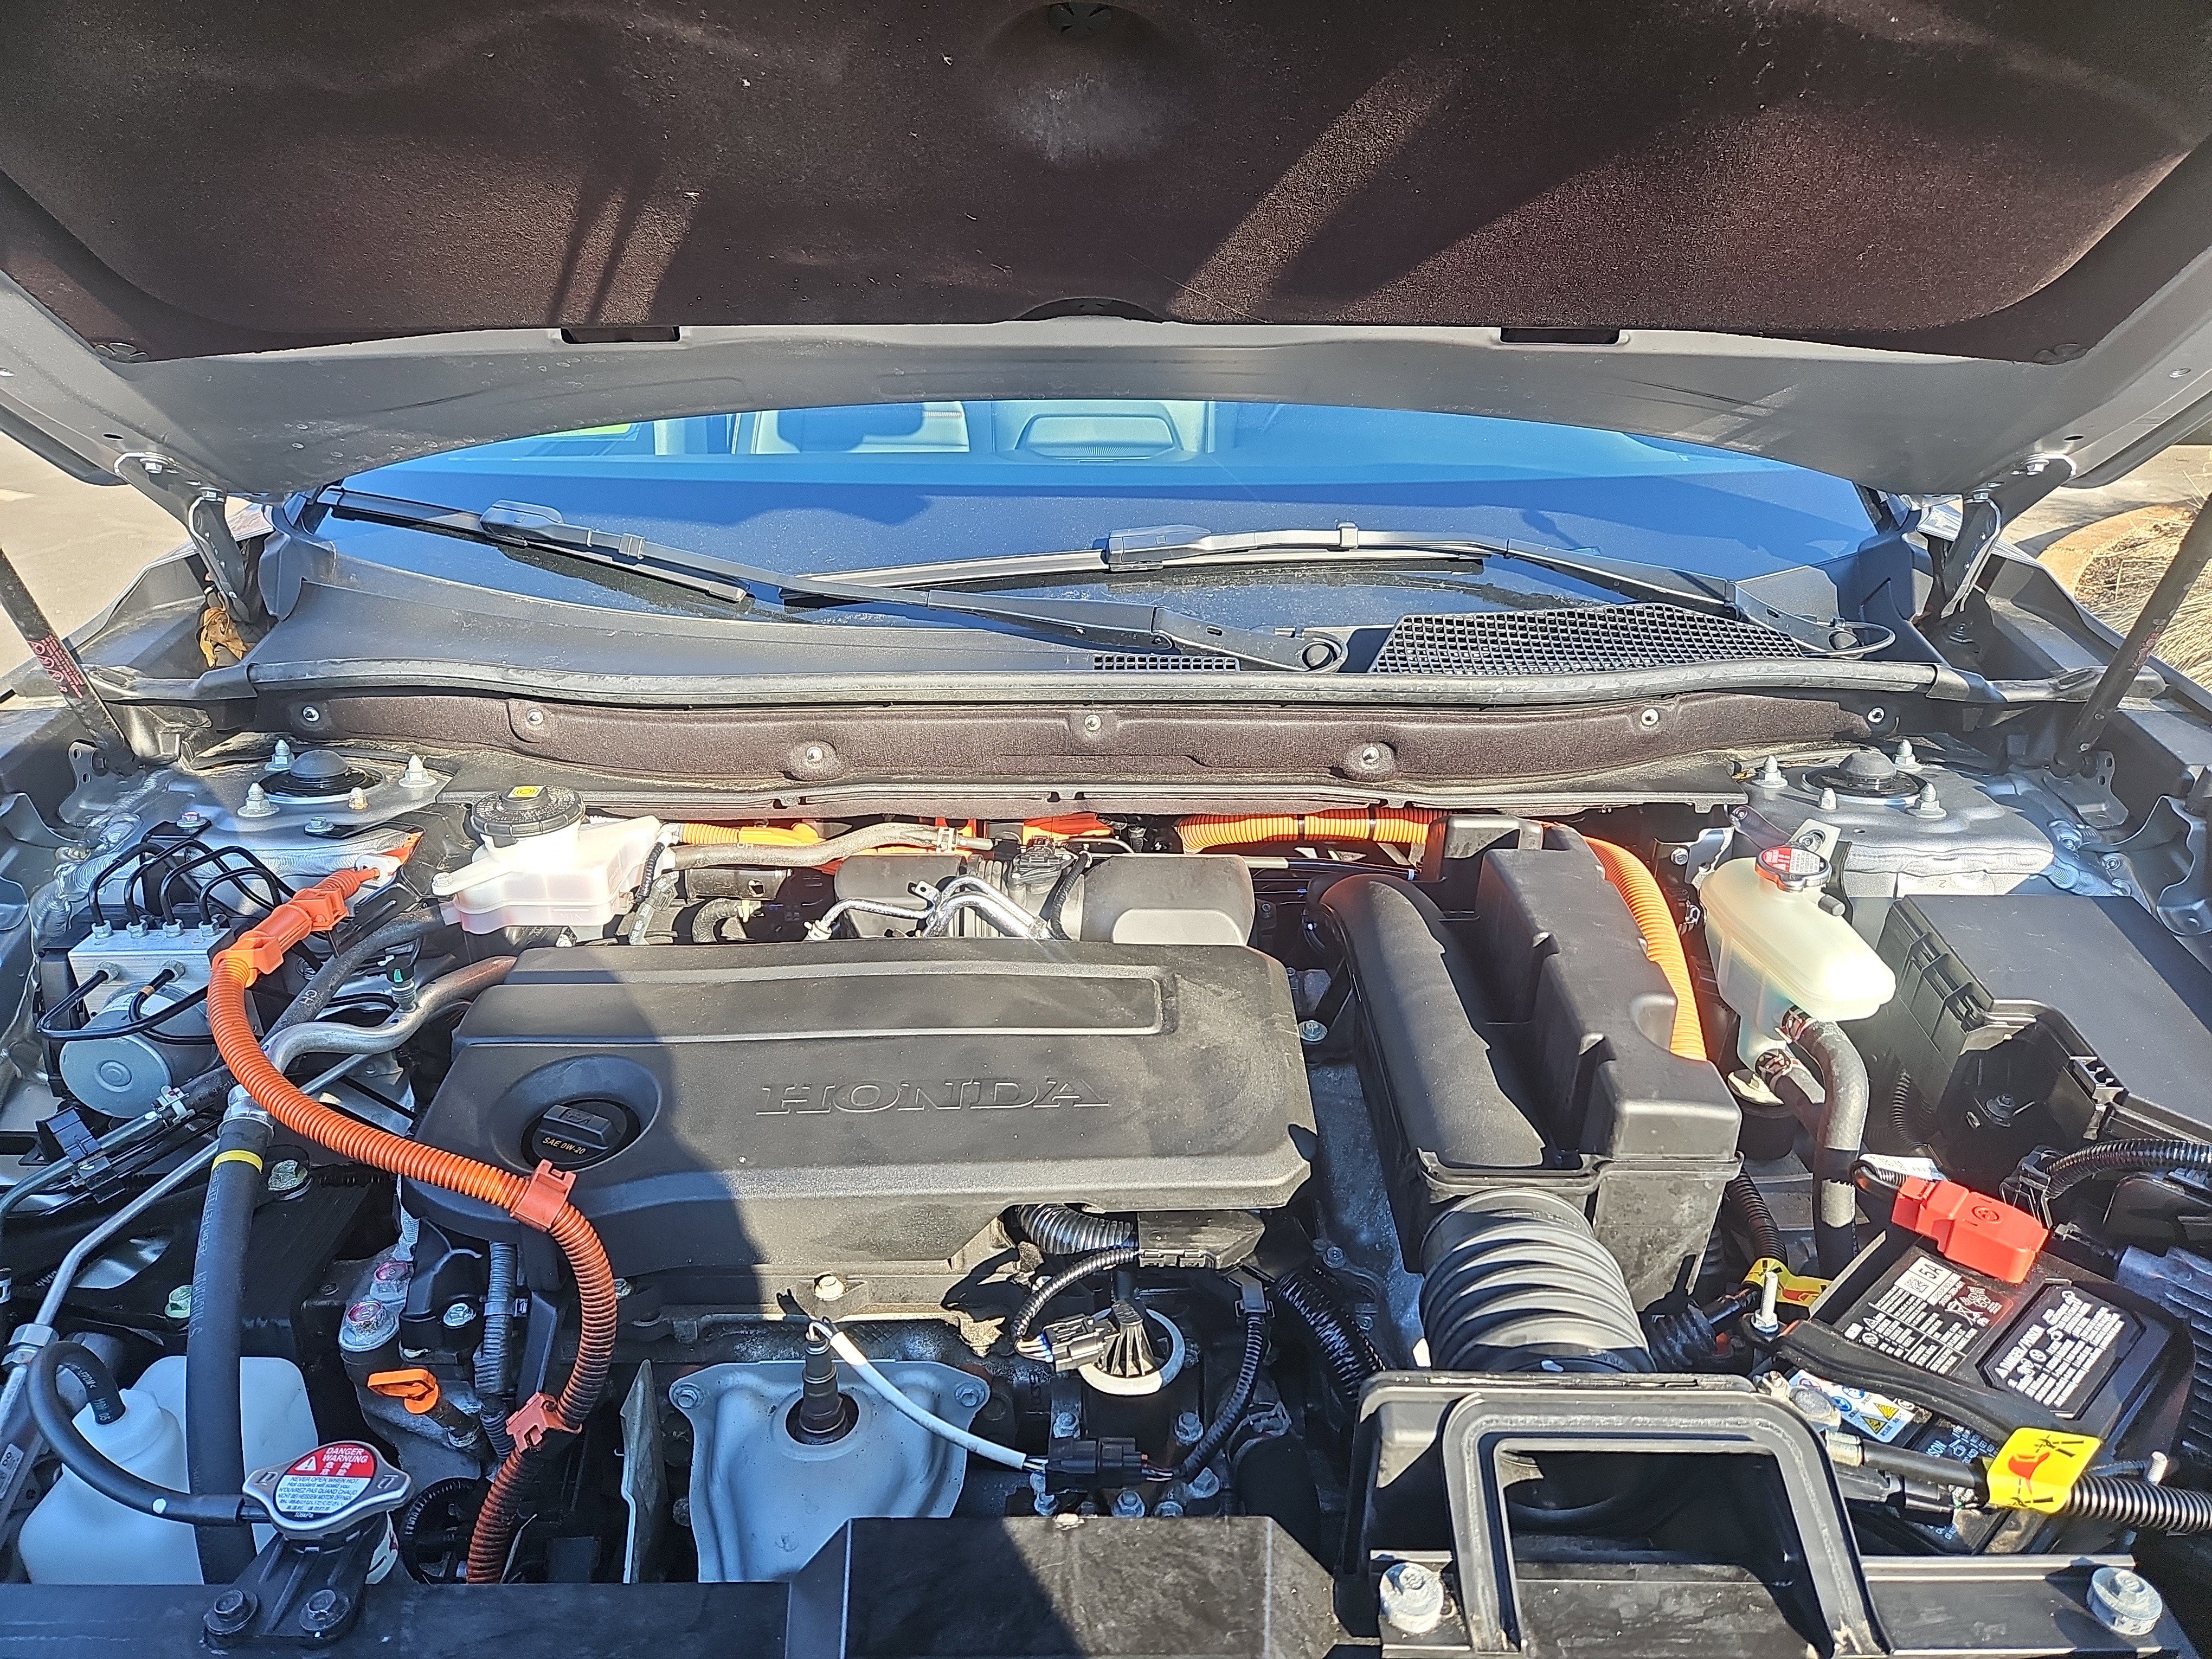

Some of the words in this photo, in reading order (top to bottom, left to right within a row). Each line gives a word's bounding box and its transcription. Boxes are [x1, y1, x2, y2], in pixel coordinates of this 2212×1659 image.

[560, 913, 583, 921] MIN
[755, 1077, 1109, 1115] HONDA
[543, 1137, 562, 1147] SAE
[560, 1142, 586, 1155] 0W-20
[1918, 1263, 1944, 1279] 5A
[323, 1454, 369, 1463] WARNUNG
